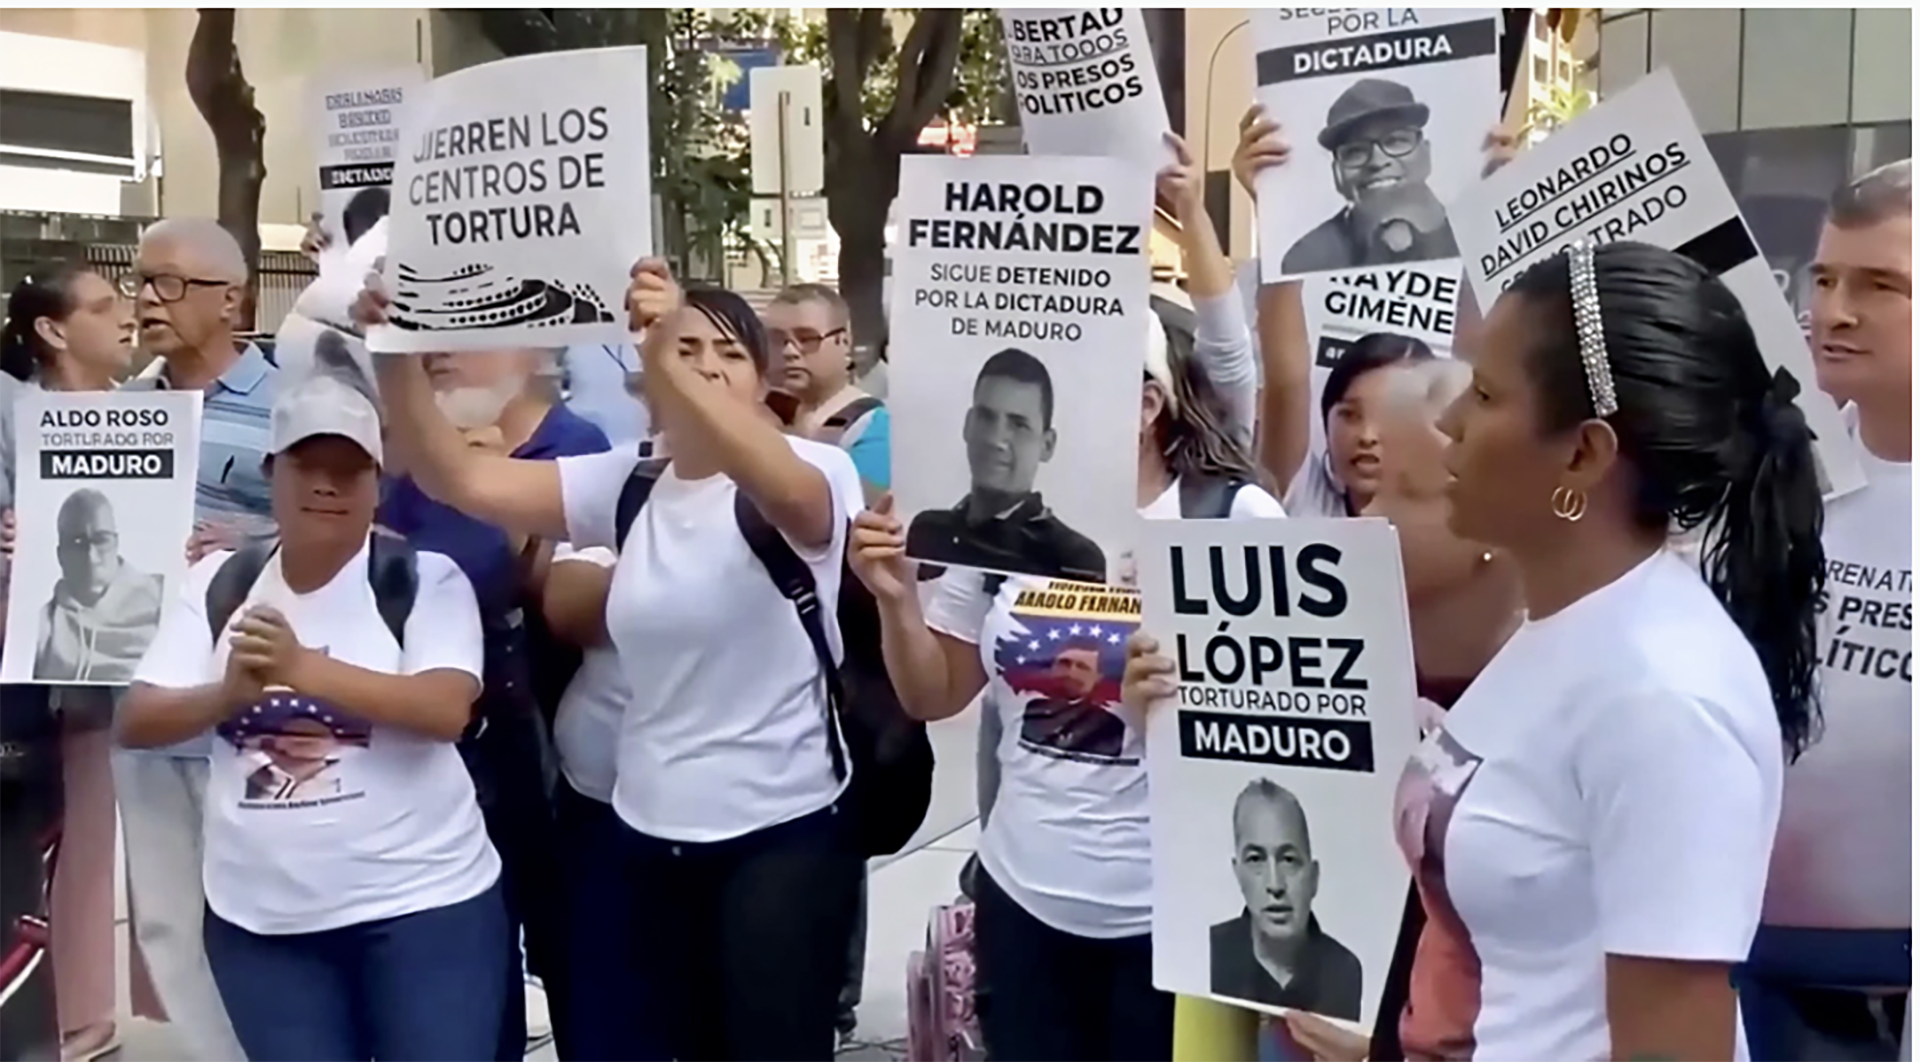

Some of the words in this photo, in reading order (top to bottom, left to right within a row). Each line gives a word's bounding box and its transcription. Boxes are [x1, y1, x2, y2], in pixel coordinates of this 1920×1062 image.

[1009, 8, 1123, 42] BERTAD
[1328, 14, 1379, 35] POR
[1387, 8, 1418, 27] LA
[1042, 53, 1135, 89] PRESOS
[1293, 34, 1452, 74] DICTADURA
[542, 106, 608, 146] LOS
[409, 159, 547, 206] CENTROS
[558, 153, 605, 189] DE
[1494, 133, 1631, 227] LEONARDO
[945, 182, 1104, 214] HAROLD
[1480, 221, 1548, 276] DAVID
[1555, 142, 1686, 227] CHIRINOS
[426, 202, 581, 245] TORTURA
[909, 212, 1141, 255] FERNÁNDEZ
[997, 266, 1111, 287] DETENIDO
[915, 289, 958, 308] POR
[964, 291, 989, 309] LA
[995, 293, 1124, 316] DICTADURA
[951, 318, 978, 336] DE
[985, 320, 1082, 341] MADURO
[40, 410, 100, 427] ALDO
[107, 409, 168, 427] ROSO
[142, 432, 173, 446] POR
[52, 455, 161, 475] MADURO
[1170, 543, 1348, 618] LUIS
[1824, 560, 1912, 592] RENAT
[1176, 620, 1368, 690] LÓPEZ
[1178, 686, 1310, 713] TORTURADO
[1317, 693, 1367, 716] POR
[1194, 720, 1350, 761] MADURO
